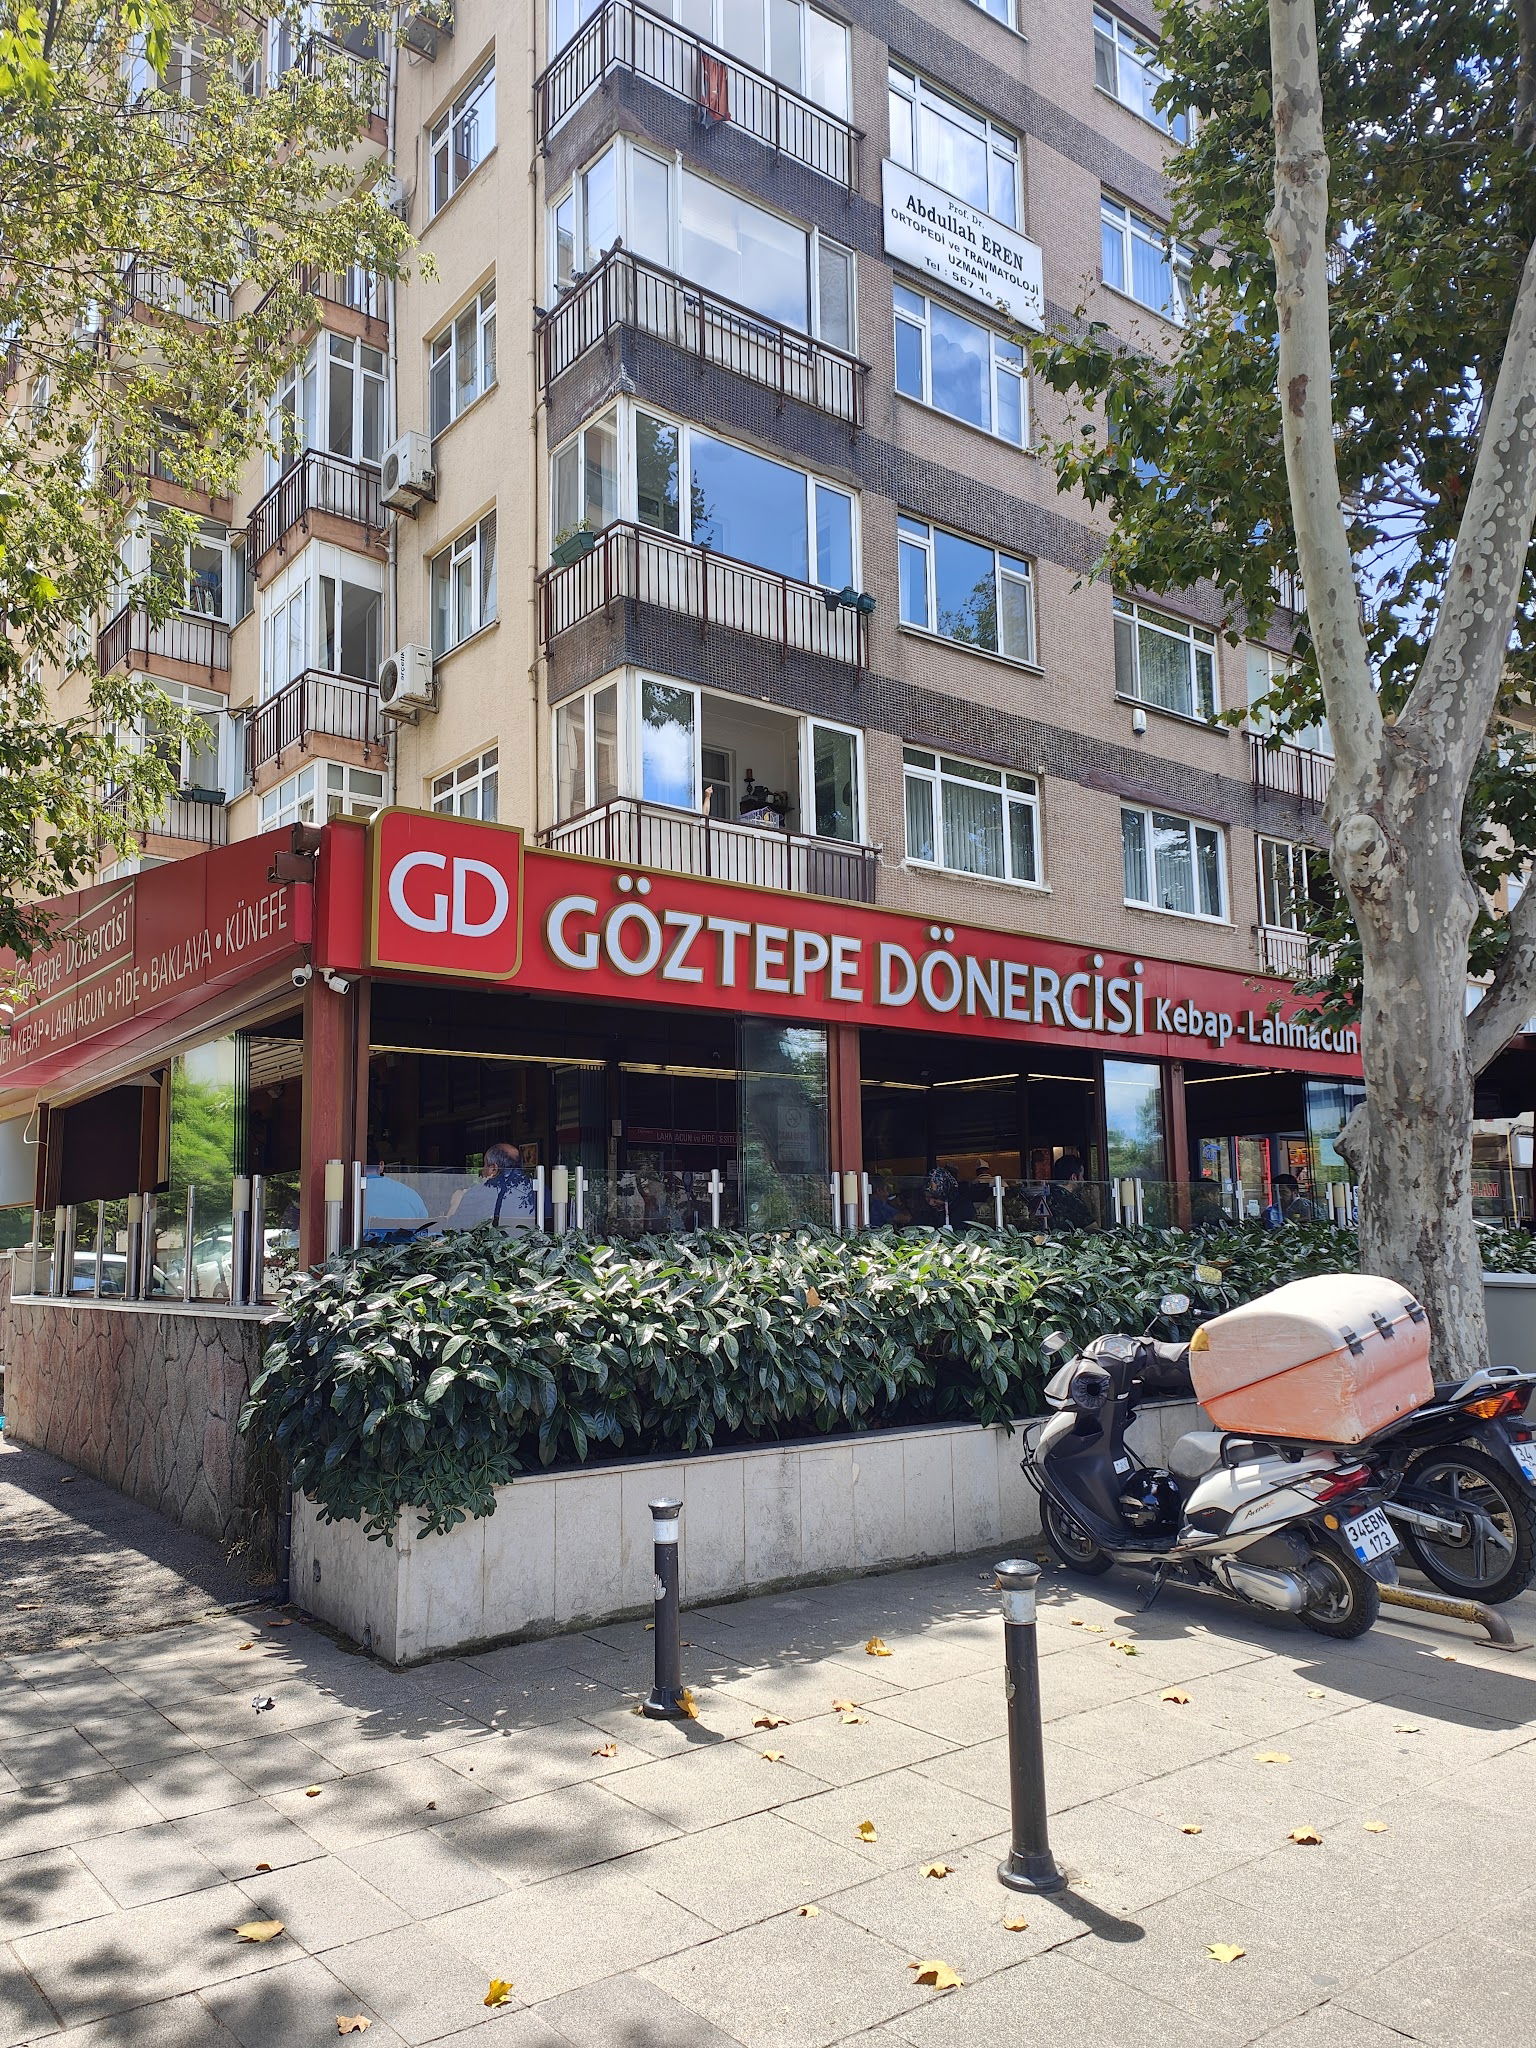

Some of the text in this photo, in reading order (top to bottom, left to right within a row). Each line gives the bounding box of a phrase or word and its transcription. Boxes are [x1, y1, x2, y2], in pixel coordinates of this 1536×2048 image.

[906, 195, 1024, 272] Abdullah EREN
[948, 202, 985, 229] Prof. Dr.
[891, 207, 1039, 295] ORTOPEDİ ve TRAVMATOLOJİ
[924, 257, 940, 272] Tel
[952, 272, 974, 289] 567
[979, 287, 993, 300] 14
[948, 254, 988, 284] UZMANI
[387, 850, 509, 938] GD
[16, 1019, 44, 1057] KEBAP
[50, 985, 106, 1042] LAHMACUN
[114, 966, 141, 1011] PİDE
[151, 928, 212, 993] BAKLAVA
[225, 886, 288, 956] KÜNEFE
[543, 873, 864, 1003] GÖZTEPE
[876, 924, 1145, 1036] DÖNERCİSİ
[1348, 1509, 1388, 1543] 34EBN
[1369, 1531, 1391, 1554] 173
